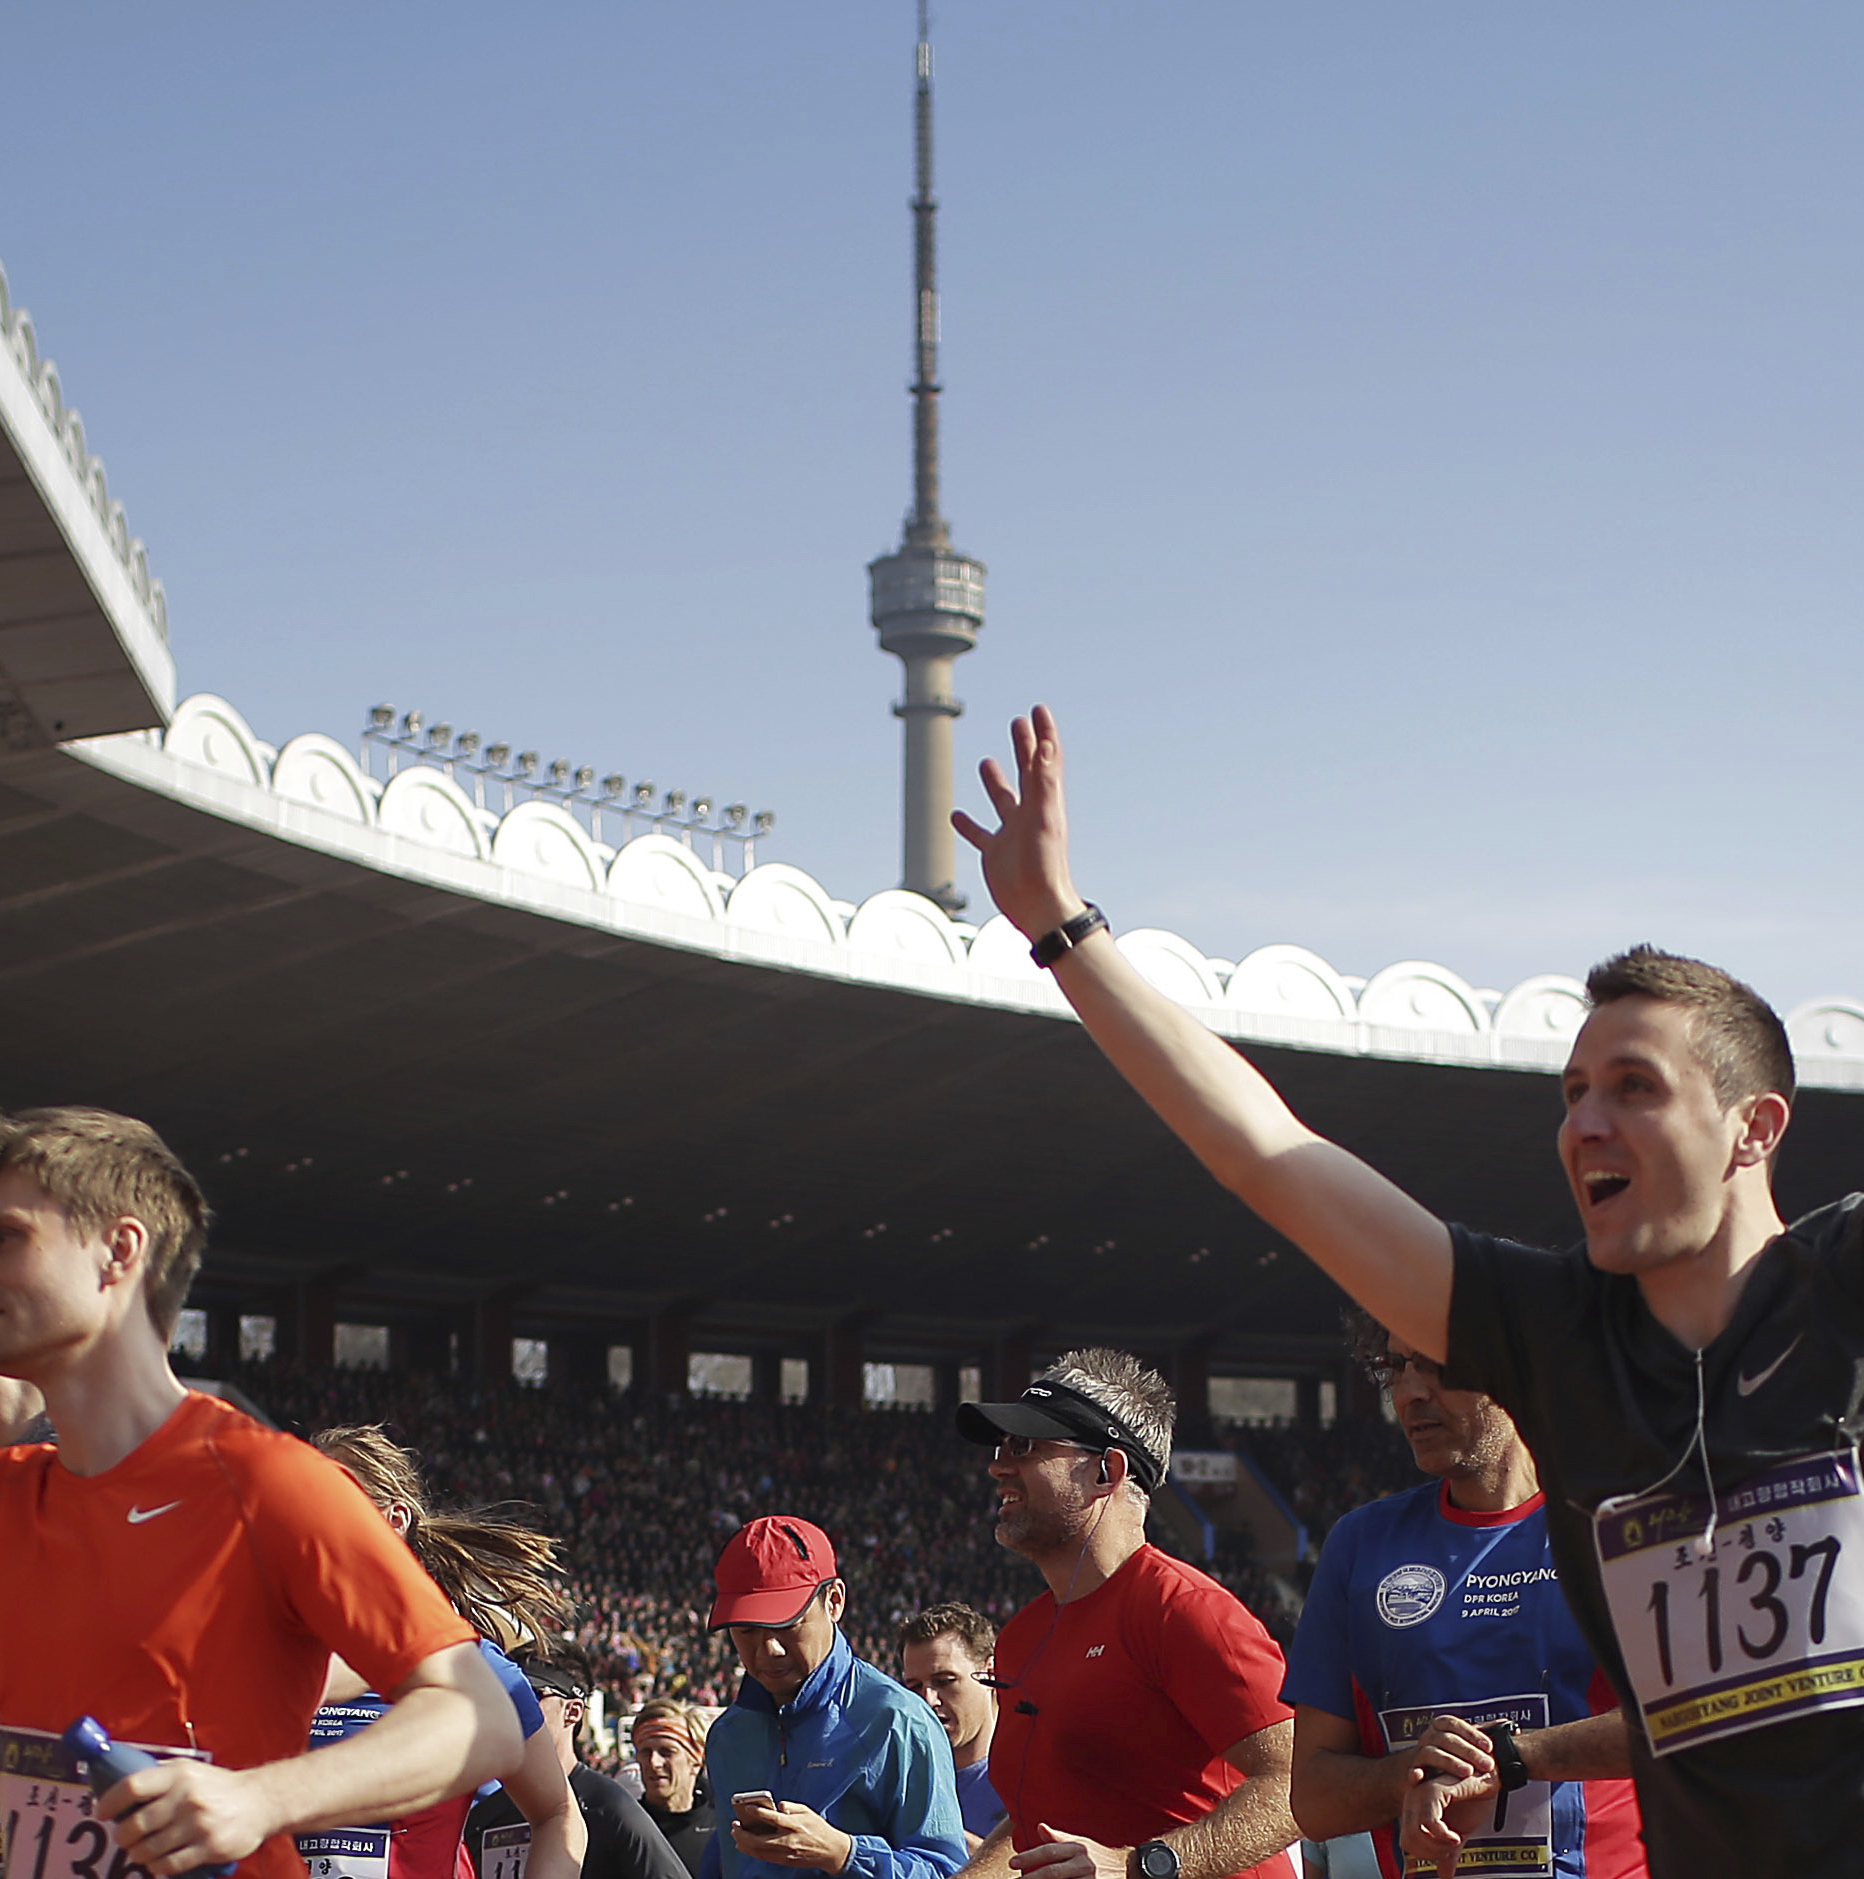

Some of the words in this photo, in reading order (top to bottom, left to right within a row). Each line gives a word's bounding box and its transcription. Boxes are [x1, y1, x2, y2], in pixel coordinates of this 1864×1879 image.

[1727, 1473, 1841, 1513] 내고향합작회사
[1463, 1594, 1485, 1604] DPR
[1486, 1592, 1519, 1603] KOREA
[1461, 1609, 1468, 1618] 9
[1469, 1607, 1500, 1618] APRIL
[1646, 1534, 1842, 1687] 1137
[1744, 1684, 1783, 1708] JOINT
[1788, 1669, 1855, 1694] VENTURE
[299, 1837, 375, 1853] 내고향합작회사
[1469, 1850, 1517, 1863] VENTURE
